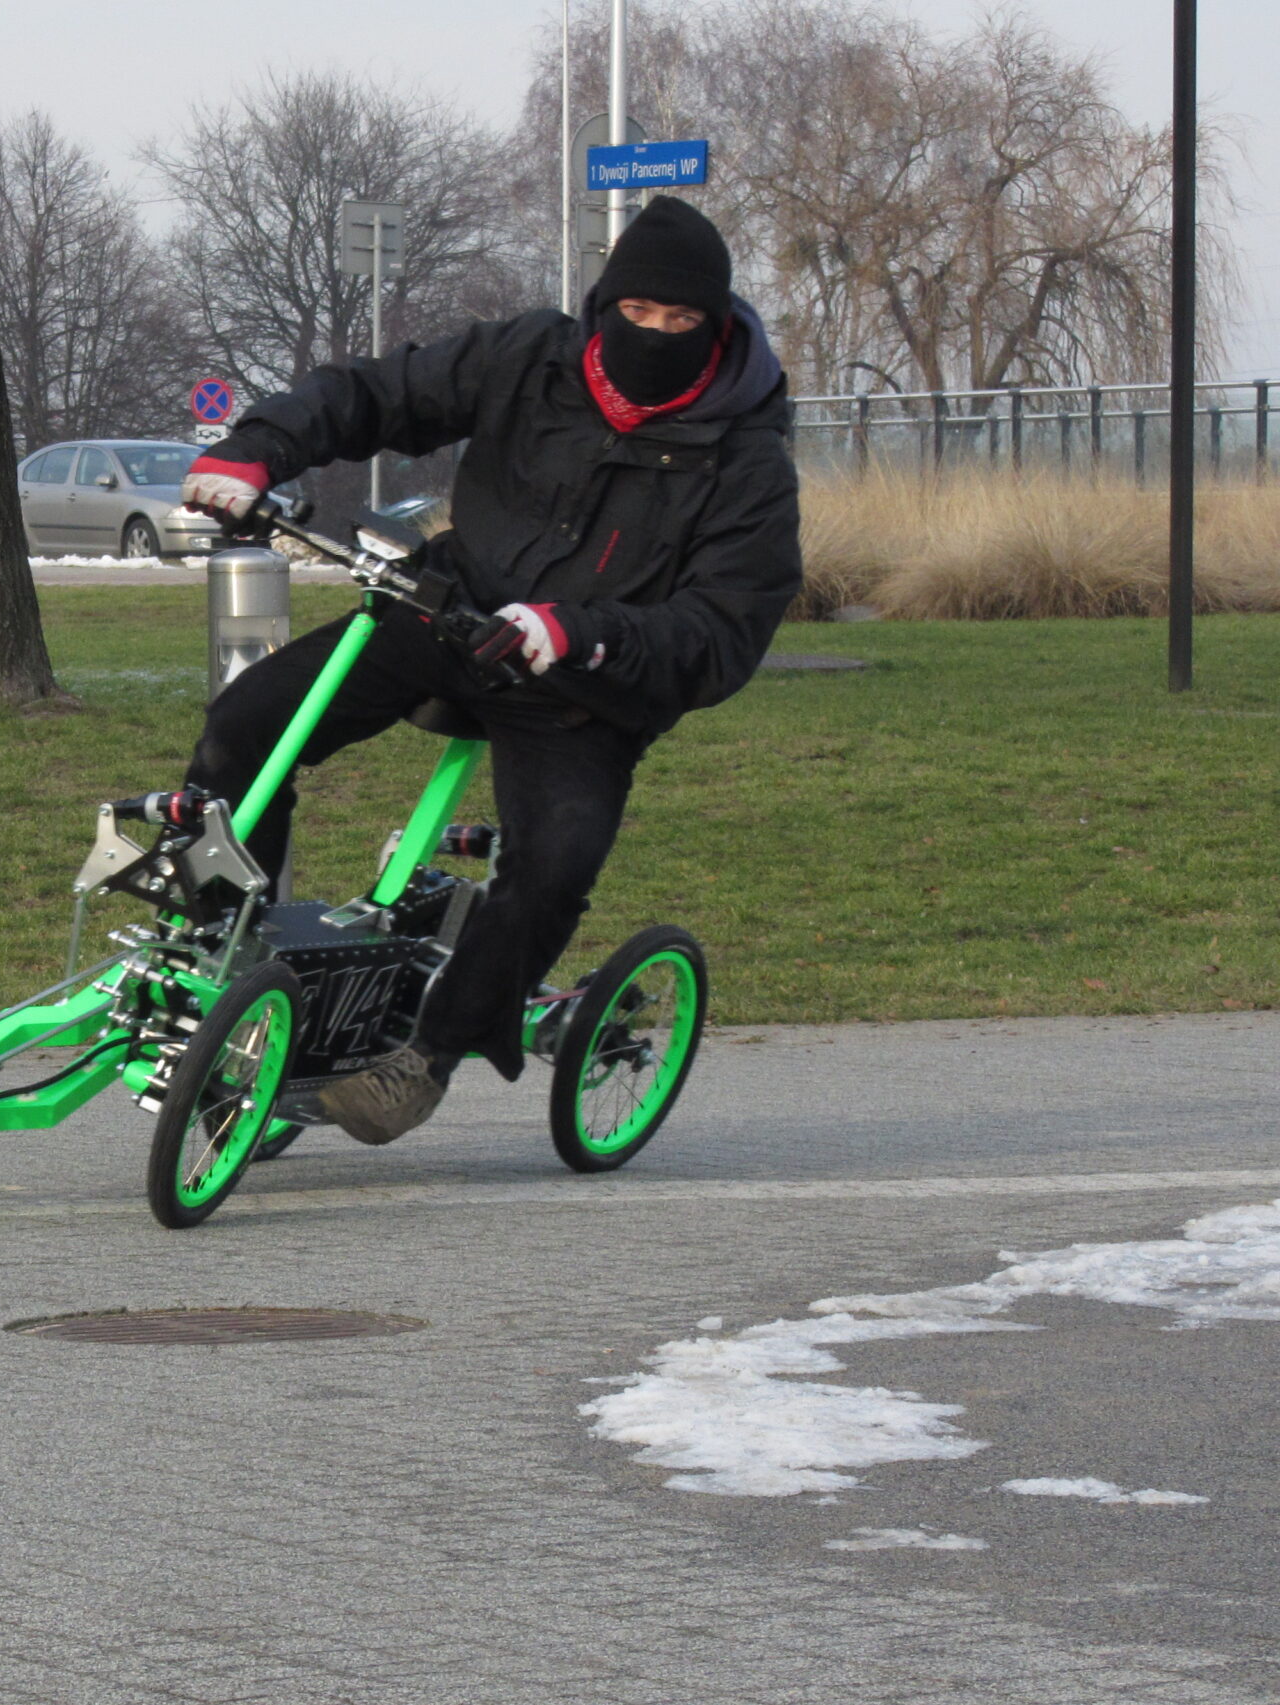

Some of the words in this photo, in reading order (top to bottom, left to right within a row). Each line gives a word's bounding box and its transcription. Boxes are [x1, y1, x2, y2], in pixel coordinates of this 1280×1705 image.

[599, 162, 629, 185] Dywizji
[631, 159, 677, 181] Pancernej
[680, 158, 698, 175] WP
